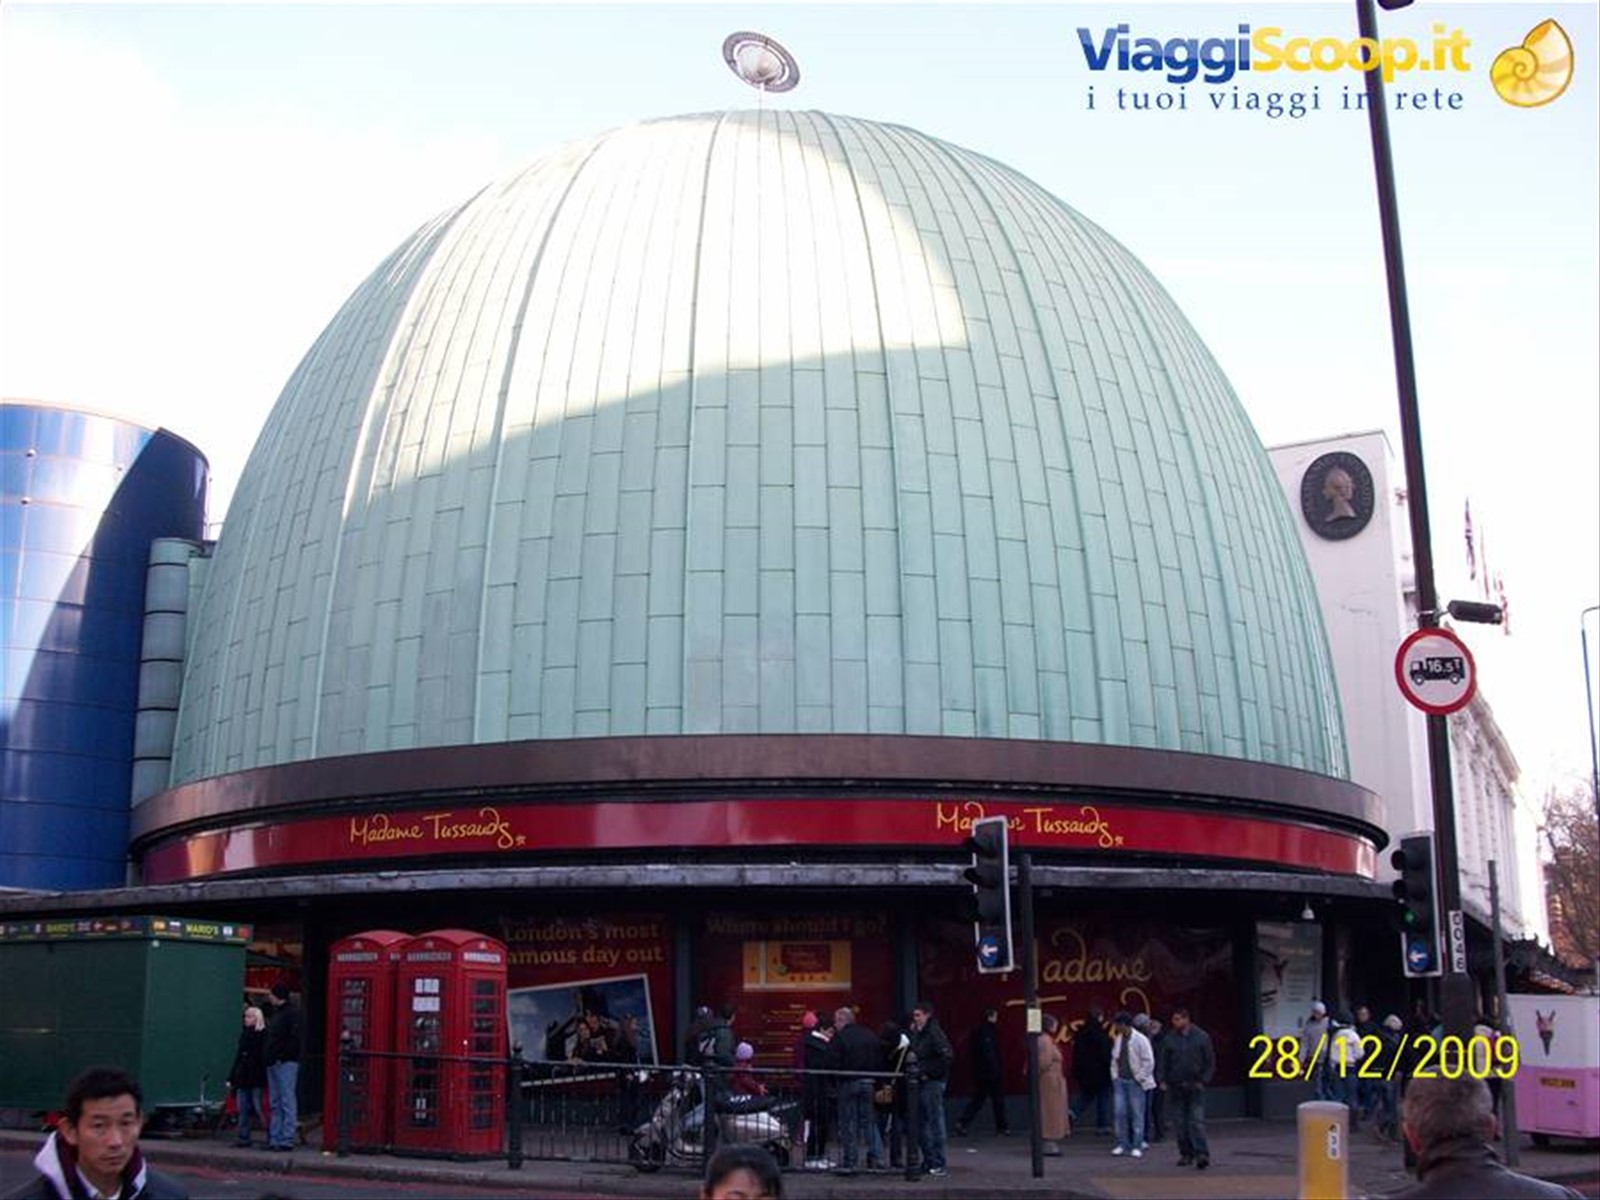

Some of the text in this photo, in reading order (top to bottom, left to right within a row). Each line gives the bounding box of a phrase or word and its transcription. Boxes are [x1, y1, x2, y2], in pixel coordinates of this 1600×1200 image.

[350, 807, 514, 849] Madame Tussauds
[1023, 806, 1114, 848] Tussauds
[505, 921, 659, 941] London's most
[507, 950, 577, 964] amous
[582, 946, 621, 967] day
[626, 947, 664, 962] out
